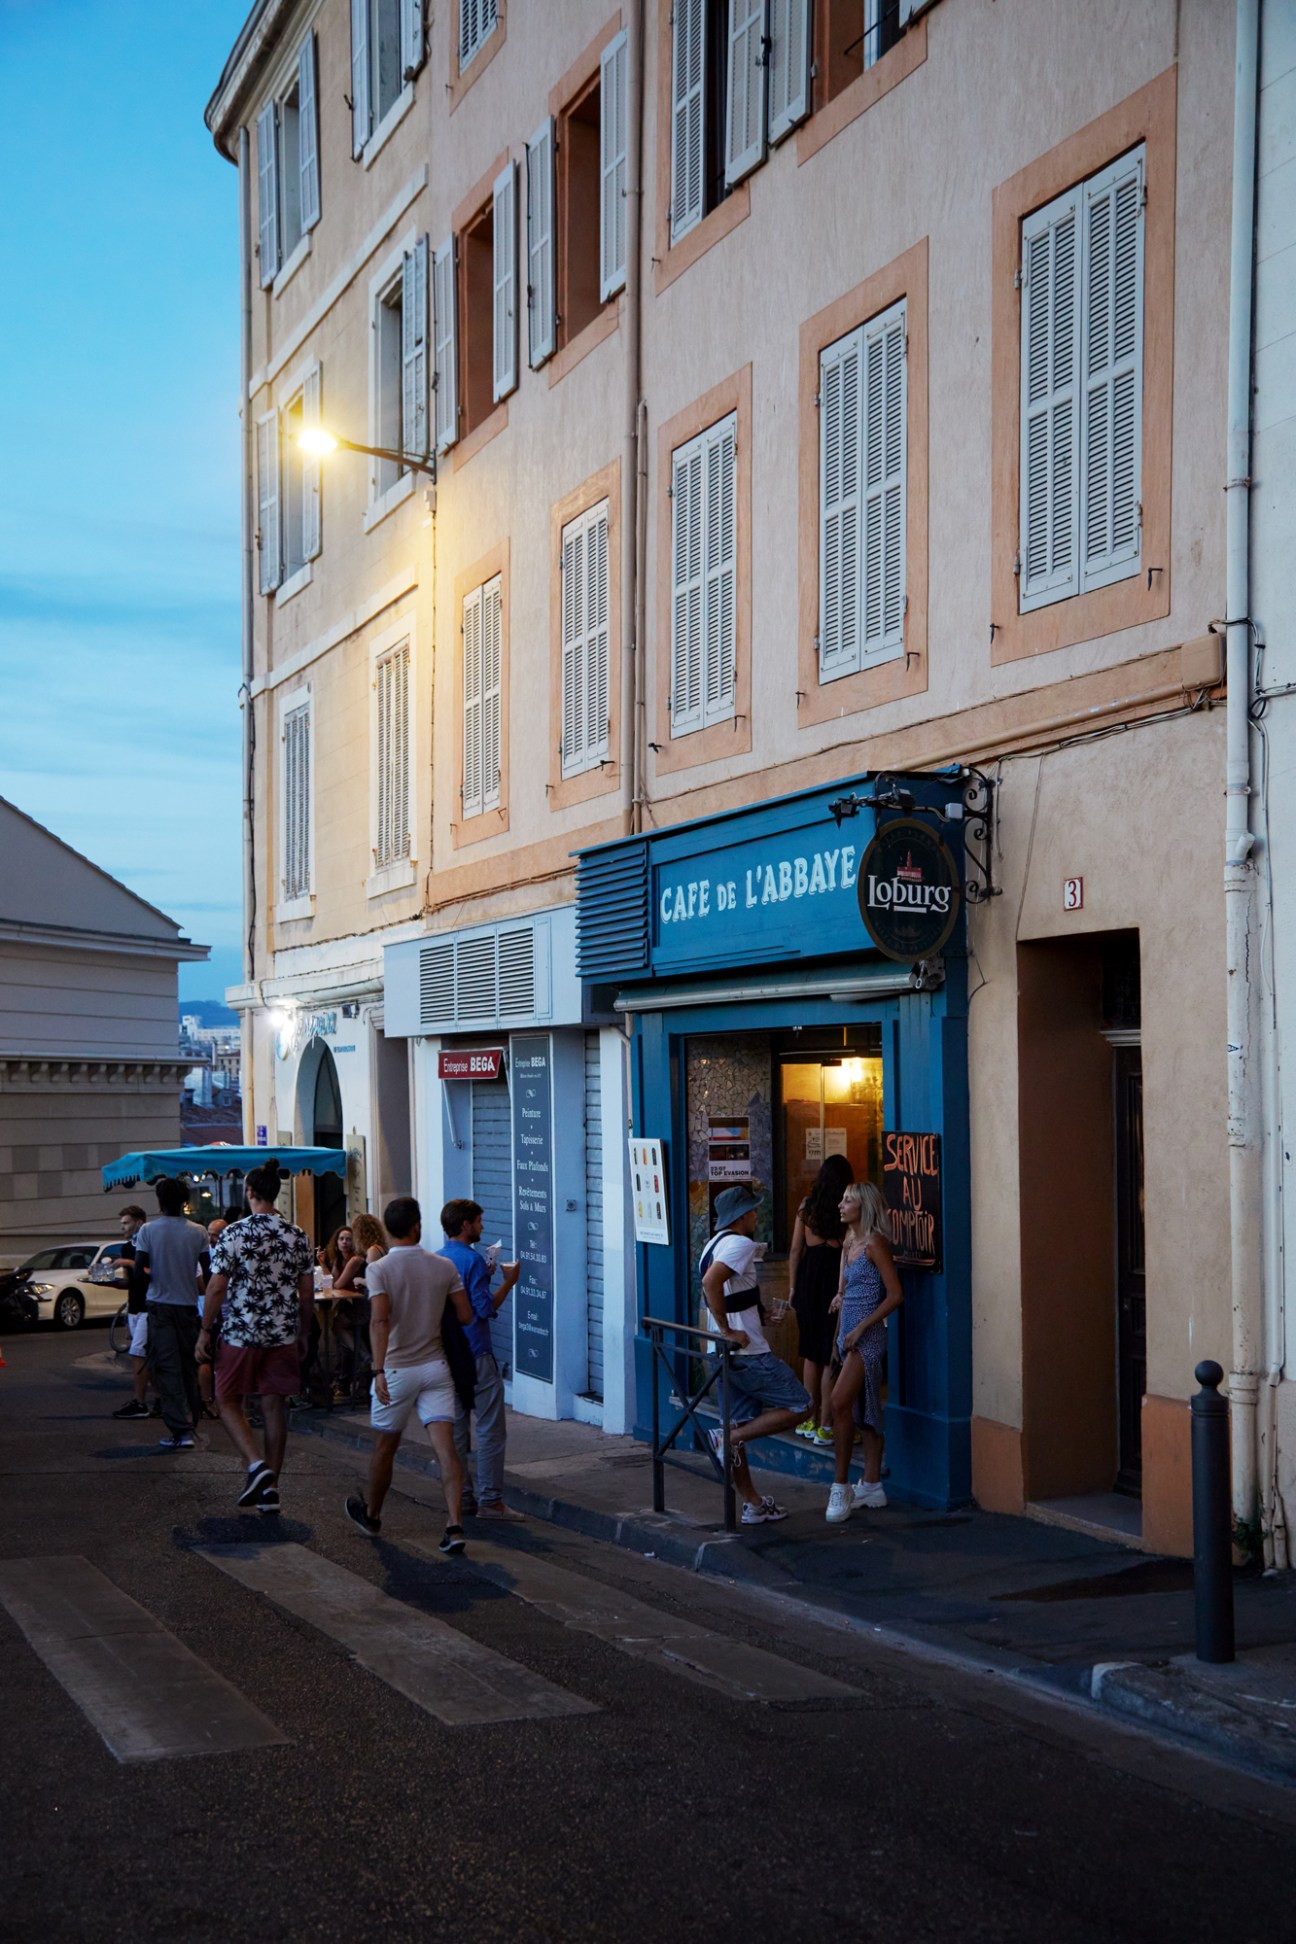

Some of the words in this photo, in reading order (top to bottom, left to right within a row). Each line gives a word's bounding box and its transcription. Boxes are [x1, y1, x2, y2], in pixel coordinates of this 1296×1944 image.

[660, 879, 710, 924] CAFE
[716, 881, 737, 911] DE
[745, 845, 856, 909] L'ABBAYE
[1068, 880, 1077, 907] 3
[867, 875, 951, 913] Loburg
[443, 1058, 468, 1074] Entreprise
[470, 1056, 495, 1072] BEGA
[531, 1056, 546, 1067] BEGA
[522, 1108, 541, 1118] Peinture
[521, 1134, 543, 1146] Tapisserie
[884, 1133, 938, 1176] SERVICE
[517, 1159, 527, 1170] Faux
[528, 1160, 549, 1172] Plafonds
[902, 1175, 922, 1211] AU
[520, 1199, 529, 1210] Sols
